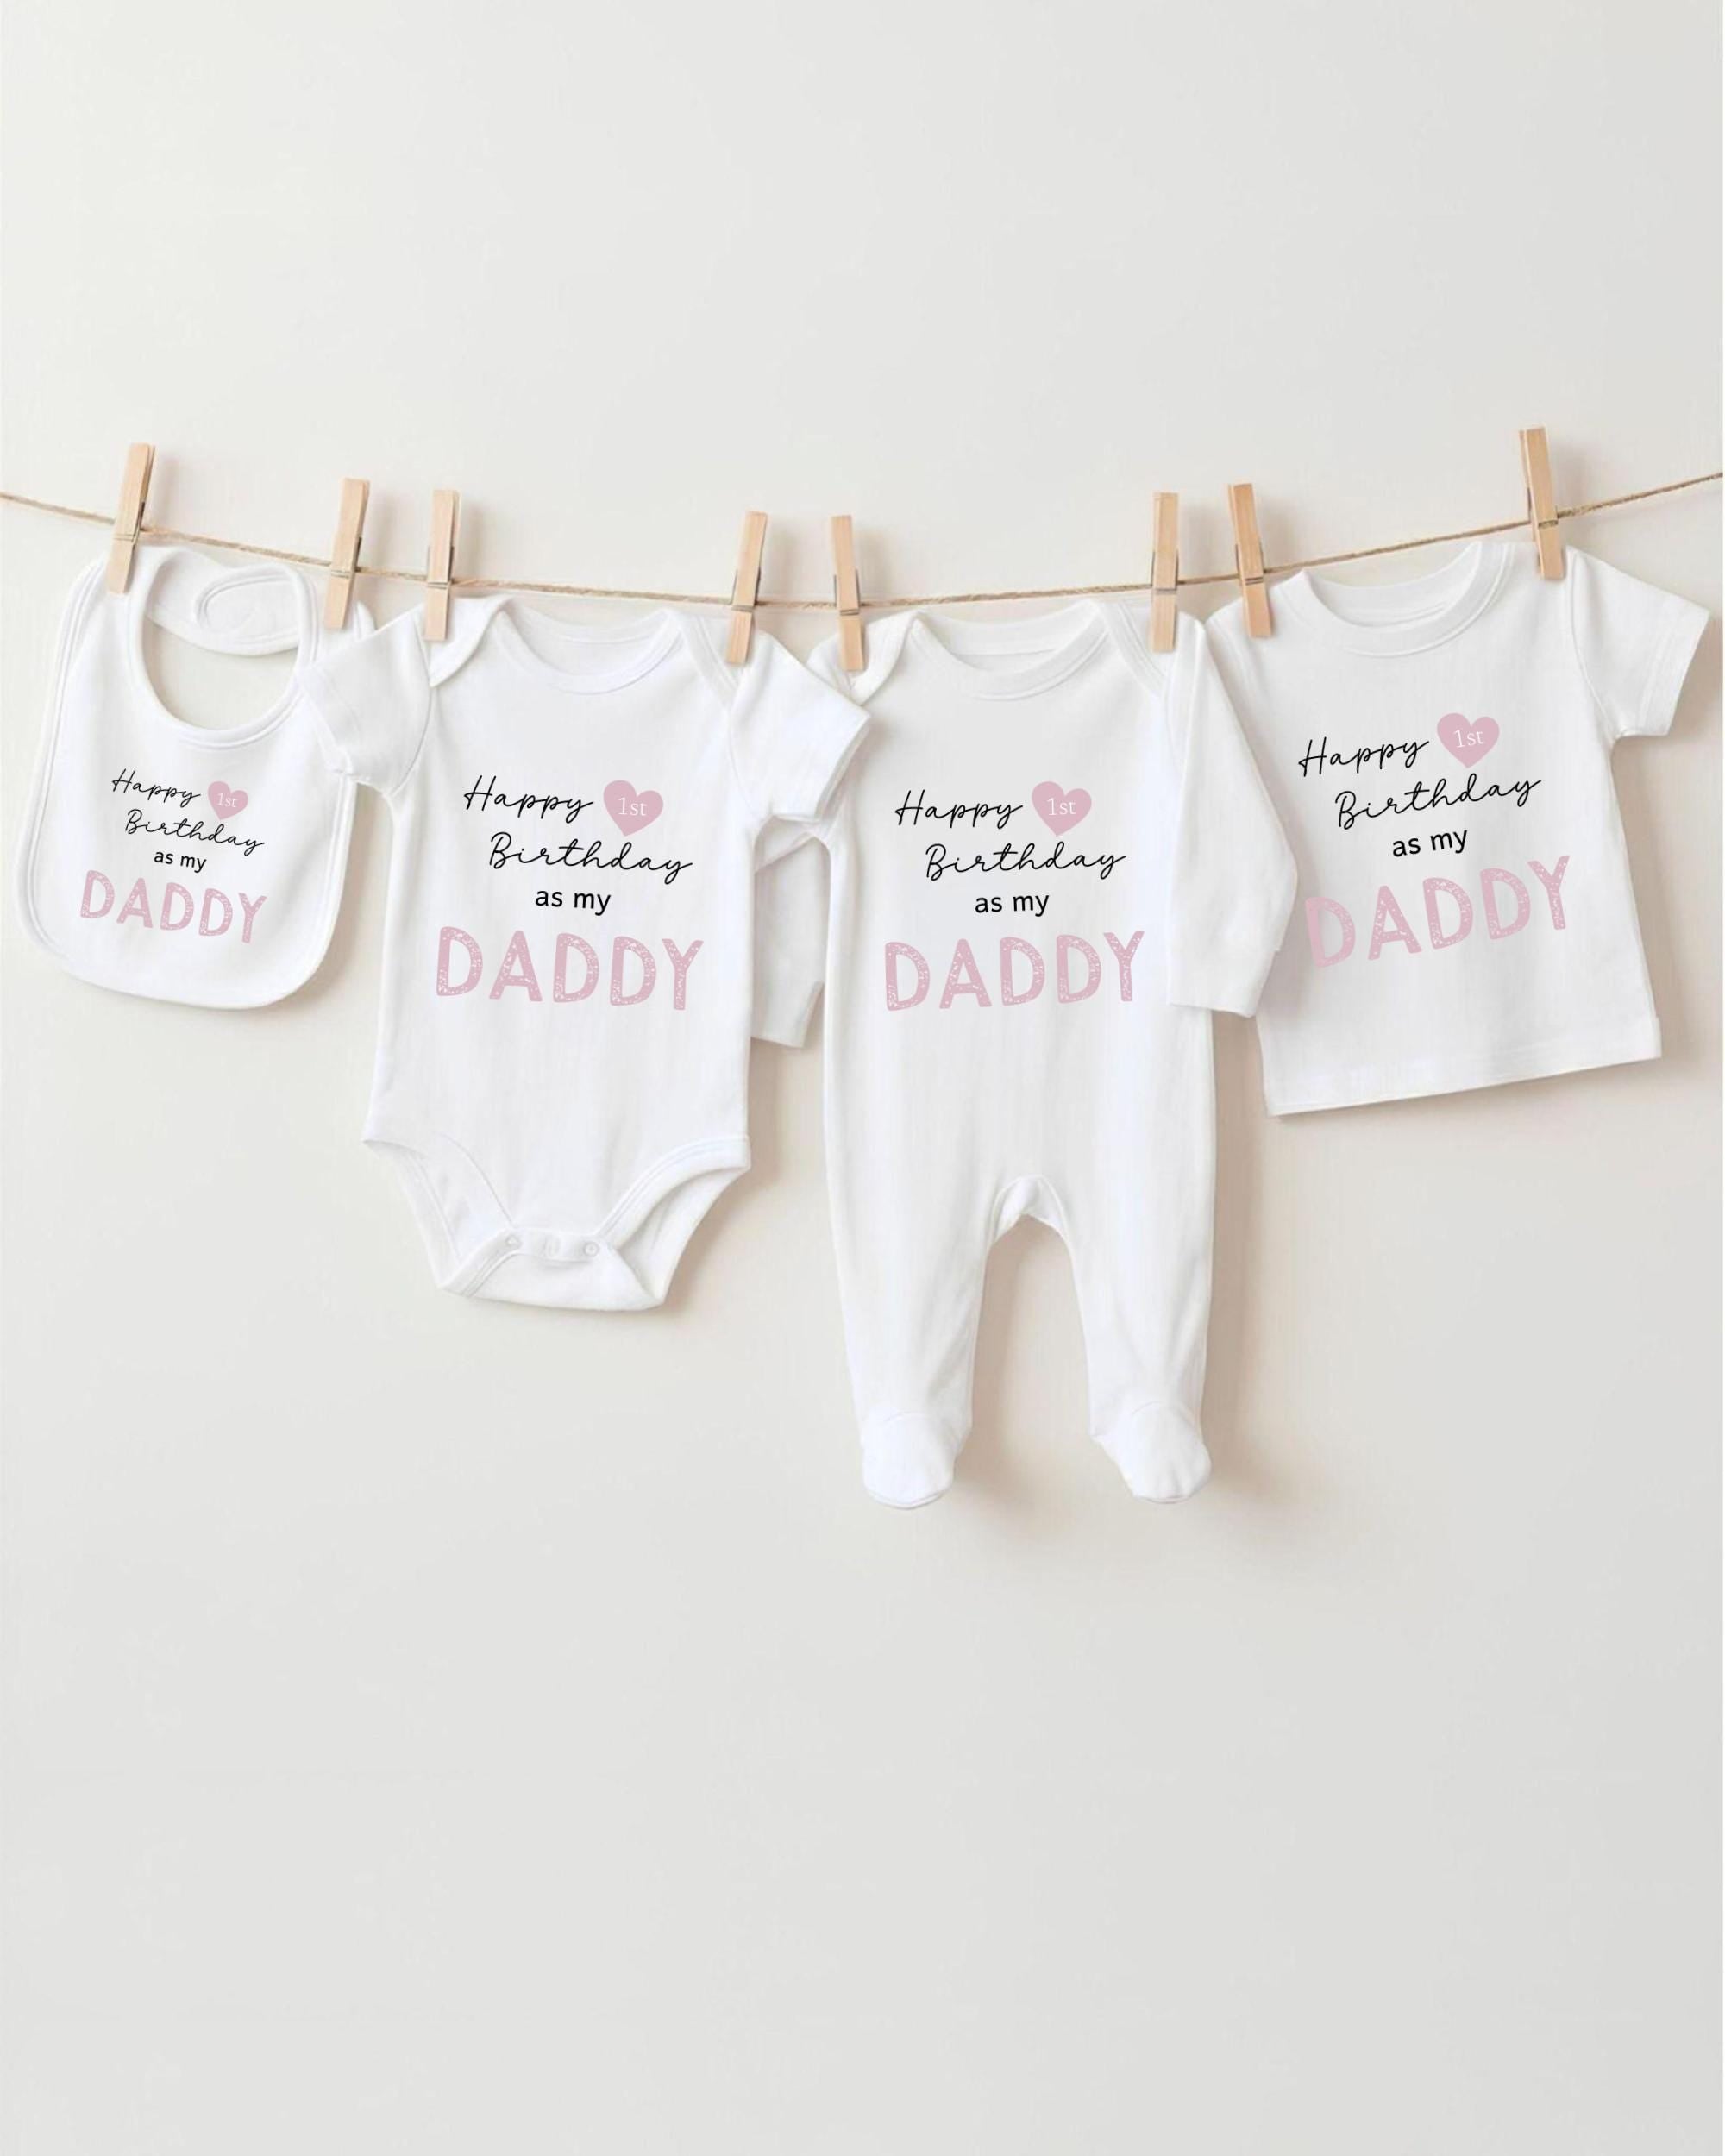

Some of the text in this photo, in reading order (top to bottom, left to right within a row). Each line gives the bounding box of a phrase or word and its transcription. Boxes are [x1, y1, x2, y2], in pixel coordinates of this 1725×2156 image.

[1299, 729, 1484, 777] Happy 1st
[112, 769, 239, 808] Happy 1st
[464, 775, 648, 824] Happy 1st
[895, 790, 1077, 829] Happy 1st
[1335, 774, 1541, 830] Birthday
[125, 809, 264, 856] Birthday
[1393, 830, 1467, 857] as my
[154, 852, 206, 873] as my
[490, 832, 693, 884] Birthday
[926, 842, 1126, 881] Birthday
[79, 870, 267, 943] DADDY
[536, 891, 611, 916] as my
[975, 895, 1049, 917] as my
[1305, 856, 1569, 967] DADDY
[436, 926, 702, 1010] DADDY
[884, 931, 1143, 1011] DADDY
